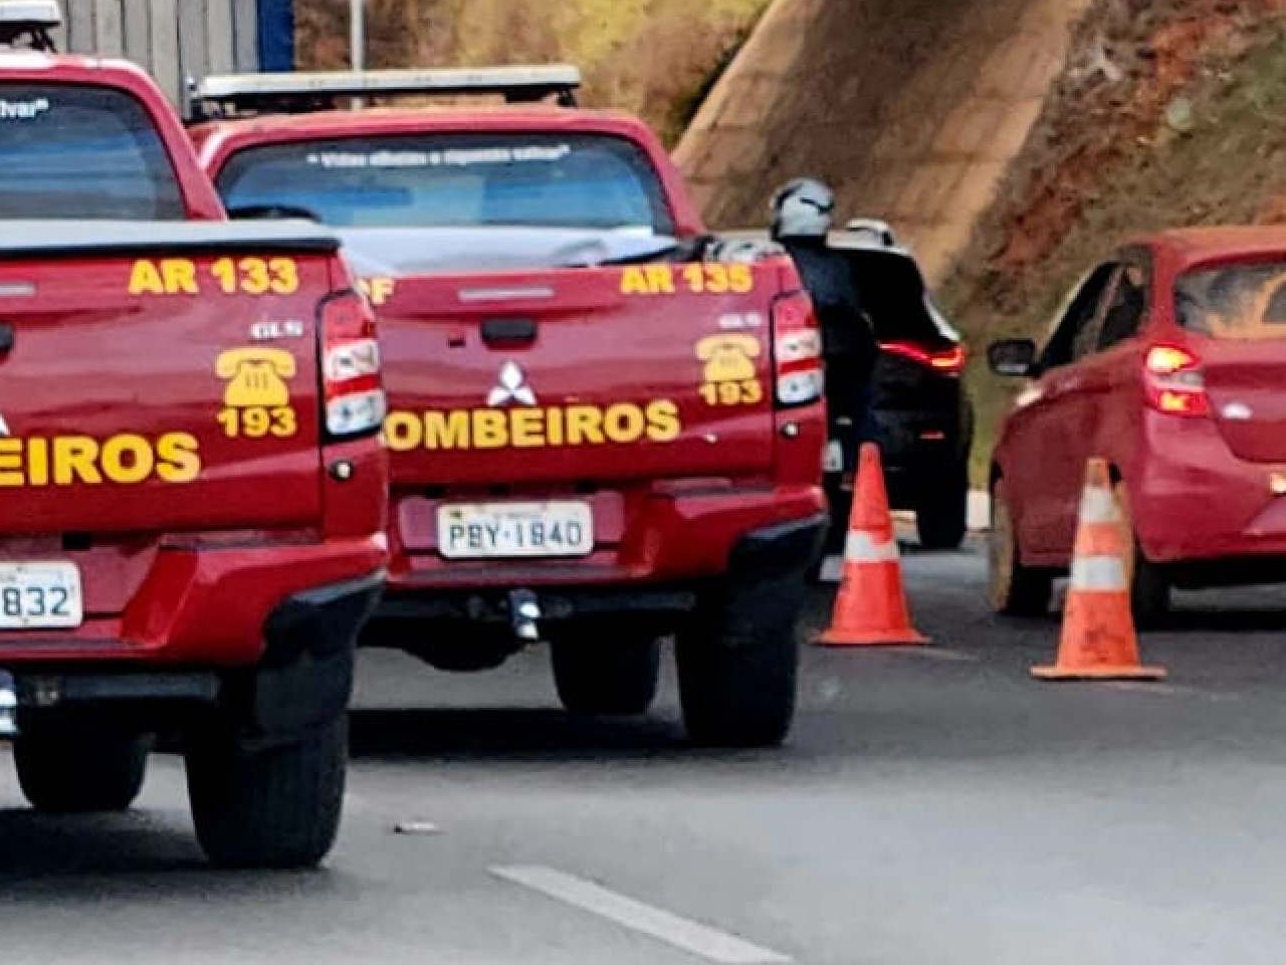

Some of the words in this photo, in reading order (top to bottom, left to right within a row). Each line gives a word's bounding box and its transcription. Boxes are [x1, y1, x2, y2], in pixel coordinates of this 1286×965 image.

[127, 258, 199, 294] AR
[211, 257, 299, 294] 133
[620, 263, 676, 294] AR
[683, 262, 753, 294] 135
[698, 379, 763, 405] 193
[217, 406, 297, 436] 193
[381, 399, 680, 450] OMBEIROS
